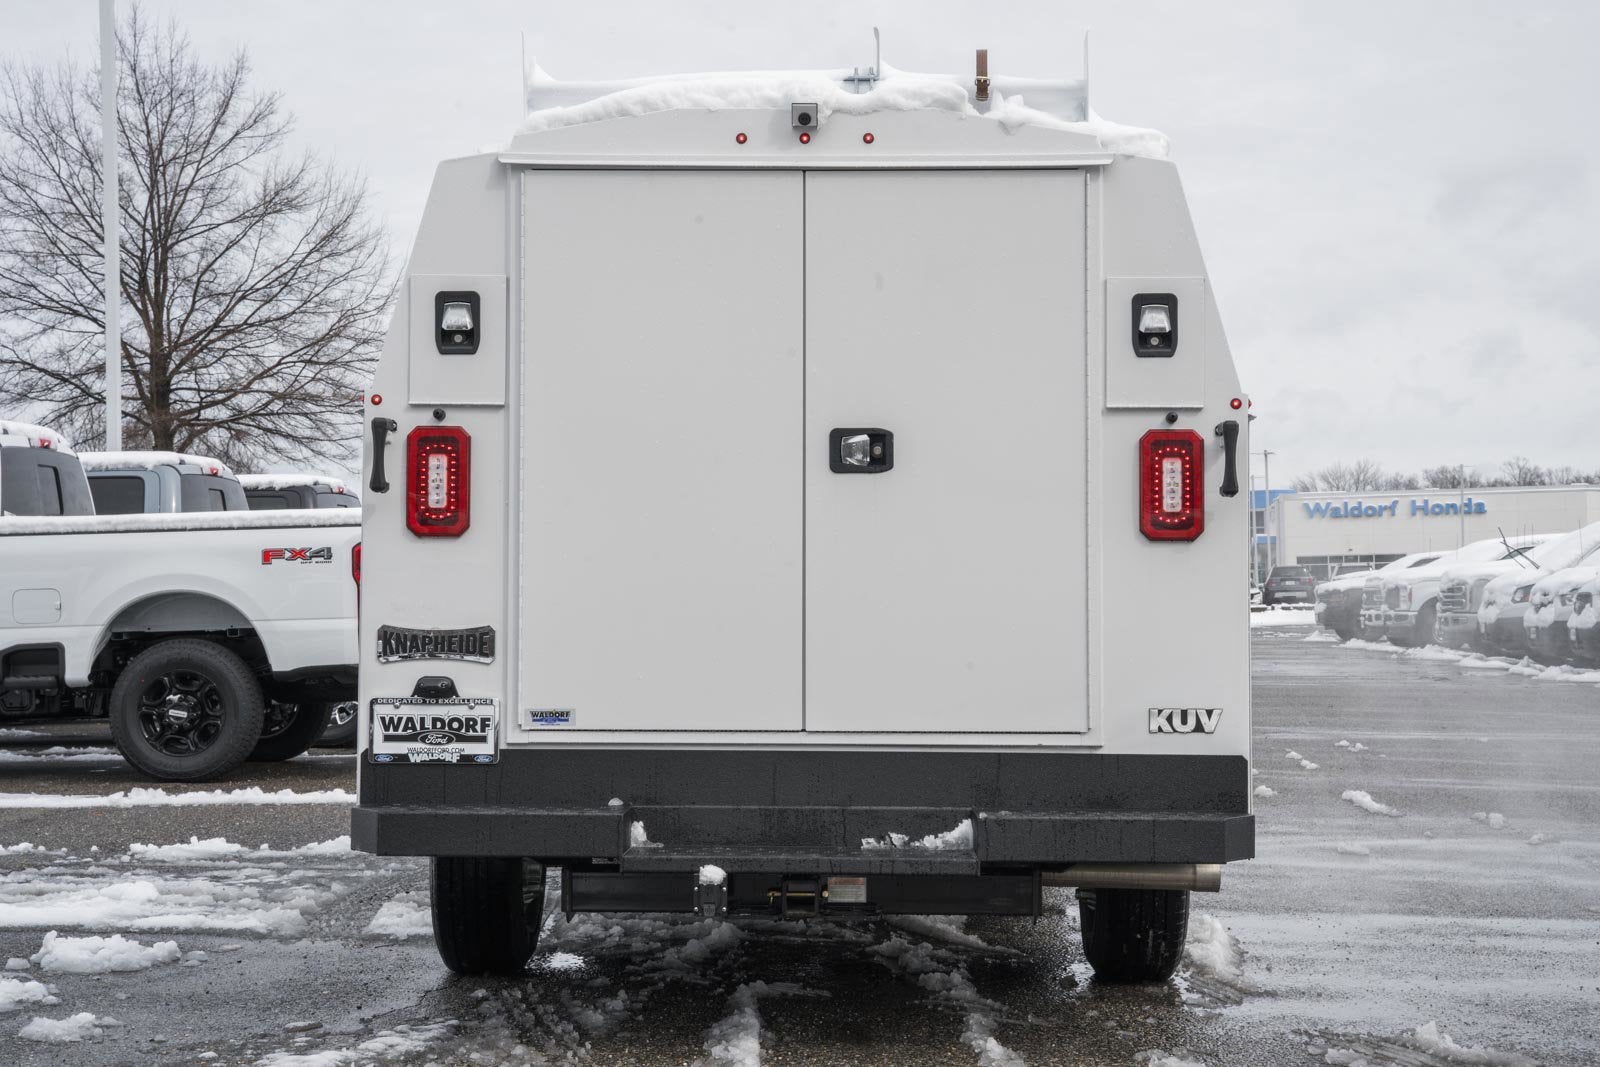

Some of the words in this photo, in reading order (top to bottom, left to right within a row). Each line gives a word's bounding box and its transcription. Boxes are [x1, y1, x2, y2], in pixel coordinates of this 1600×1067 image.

[1303, 500, 1399, 518] Waldorf
[1410, 497, 1487, 516] Honda
[261, 546, 333, 565] FX4
[382, 629, 490, 658] KNAPHEIDE
[379, 716, 491, 733] WALDORF
[1148, 707, 1223, 734] KUV
[425, 733, 449, 744] Ford
[408, 752, 460, 763] WALDORF
